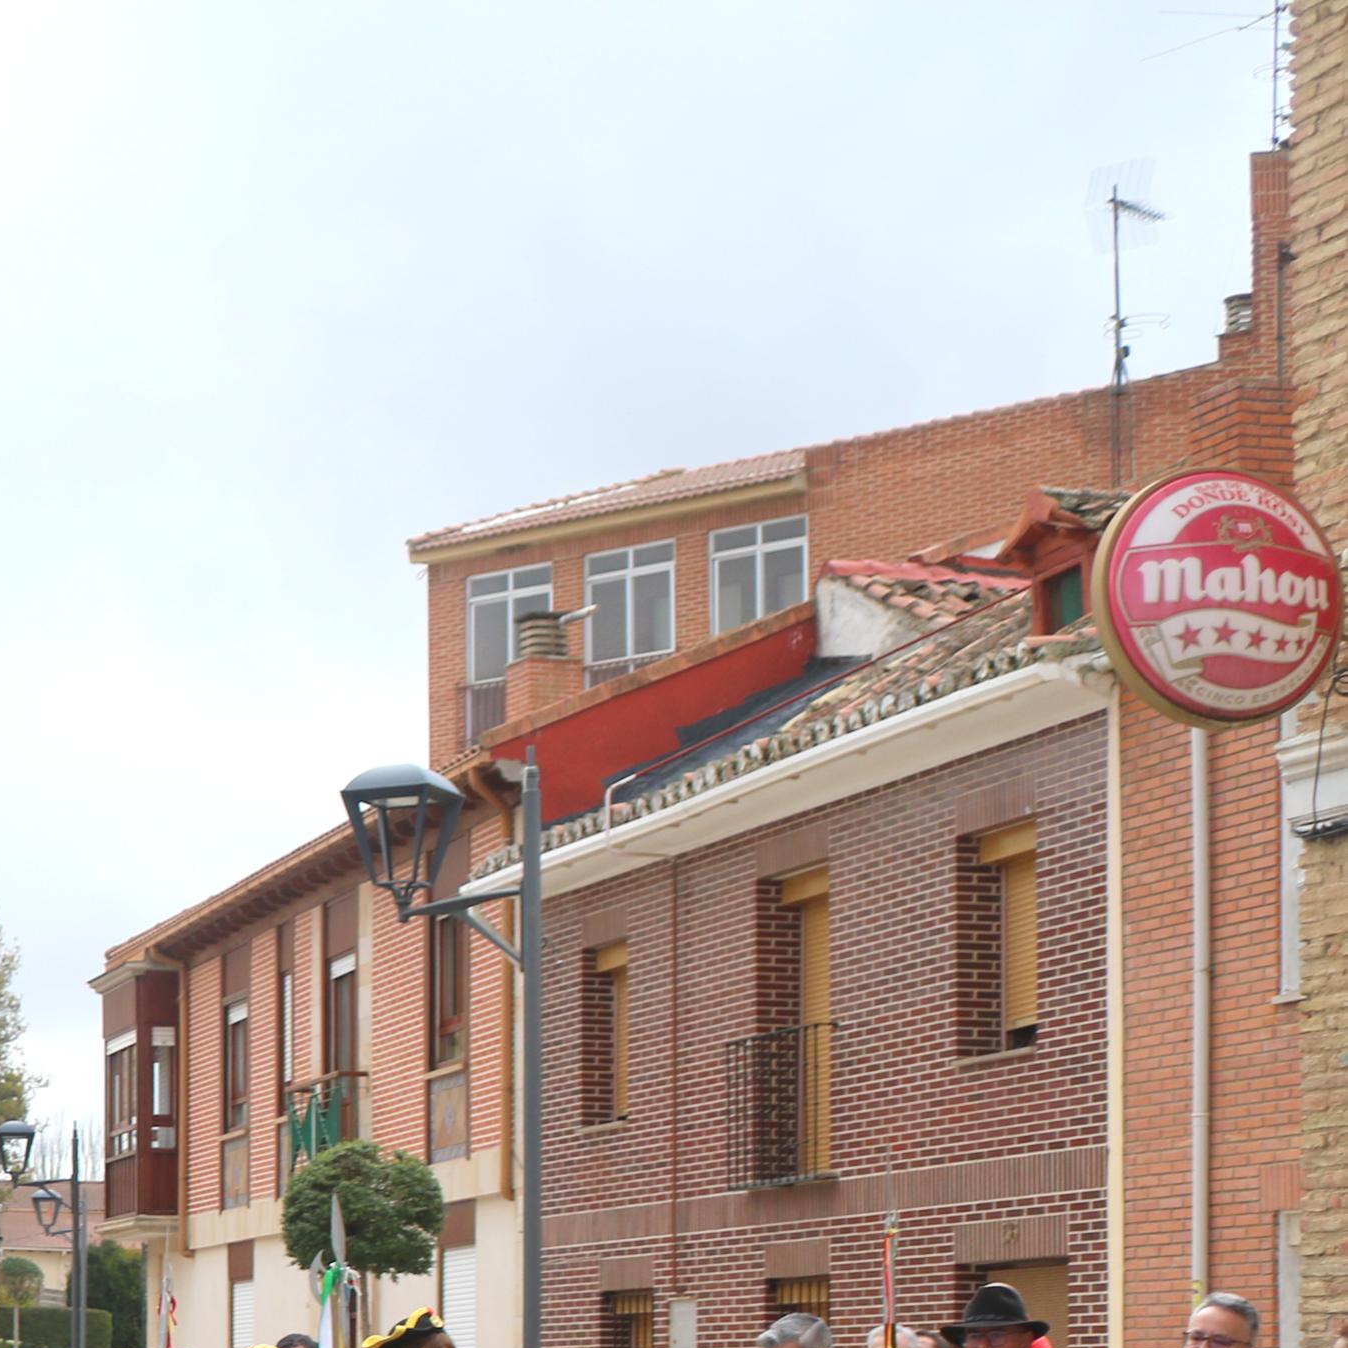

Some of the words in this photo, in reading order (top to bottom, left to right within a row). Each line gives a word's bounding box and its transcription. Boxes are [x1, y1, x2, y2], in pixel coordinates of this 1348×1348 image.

[1171, 489, 1251, 518] DONDE
[1138, 554, 1329, 610] Mahou
[1196, 685, 1245, 705] CINCO
